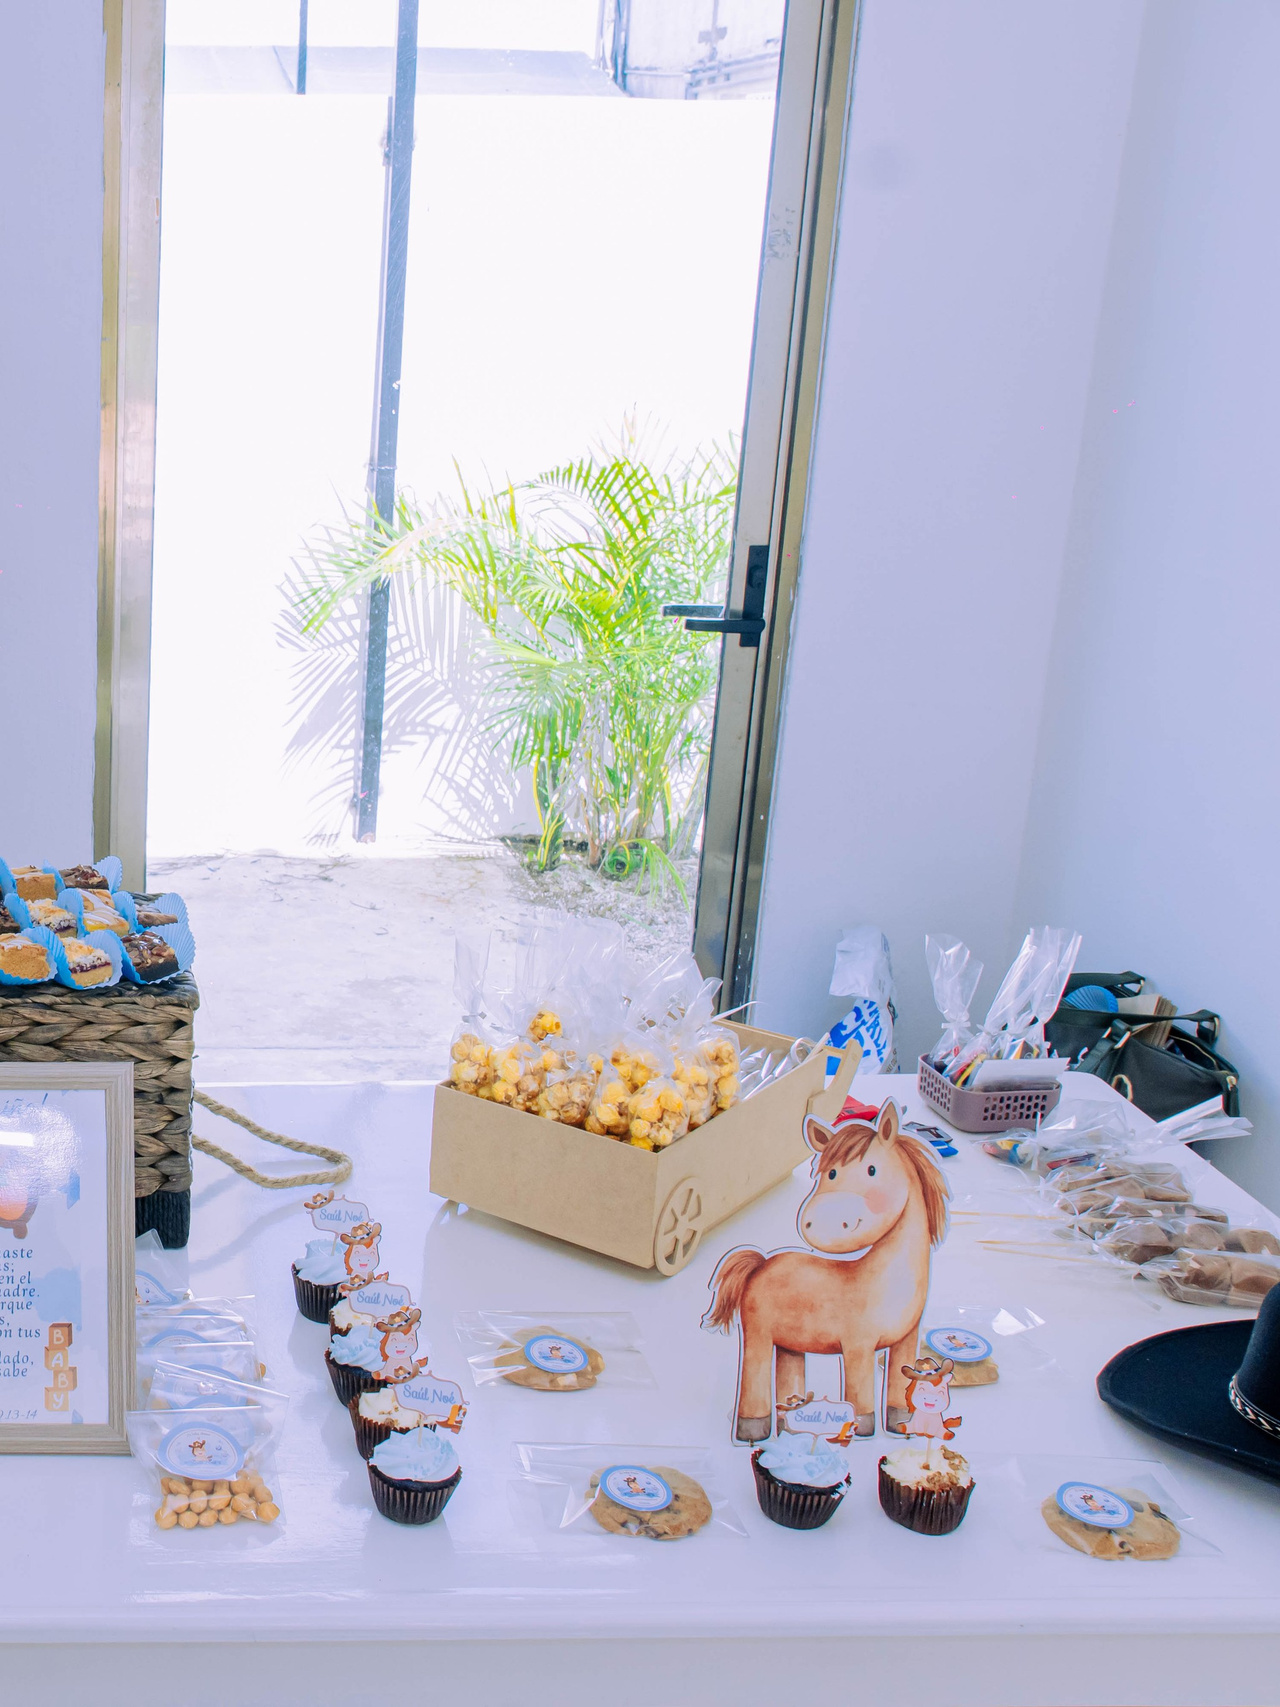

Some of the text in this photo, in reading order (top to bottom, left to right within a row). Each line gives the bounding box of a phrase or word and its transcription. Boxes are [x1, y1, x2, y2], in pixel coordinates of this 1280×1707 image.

[320, 1209, 364, 1223] Saúl Noé
[19, 1271, 32, 1285] el
[356, 1291, 405, 1306] Saúl Noé
[18, 1327, 41, 1338] tus
[403, 1384, 456, 1405] Saúl Noé
[794, 1410, 848, 1425] Saúl Noé
